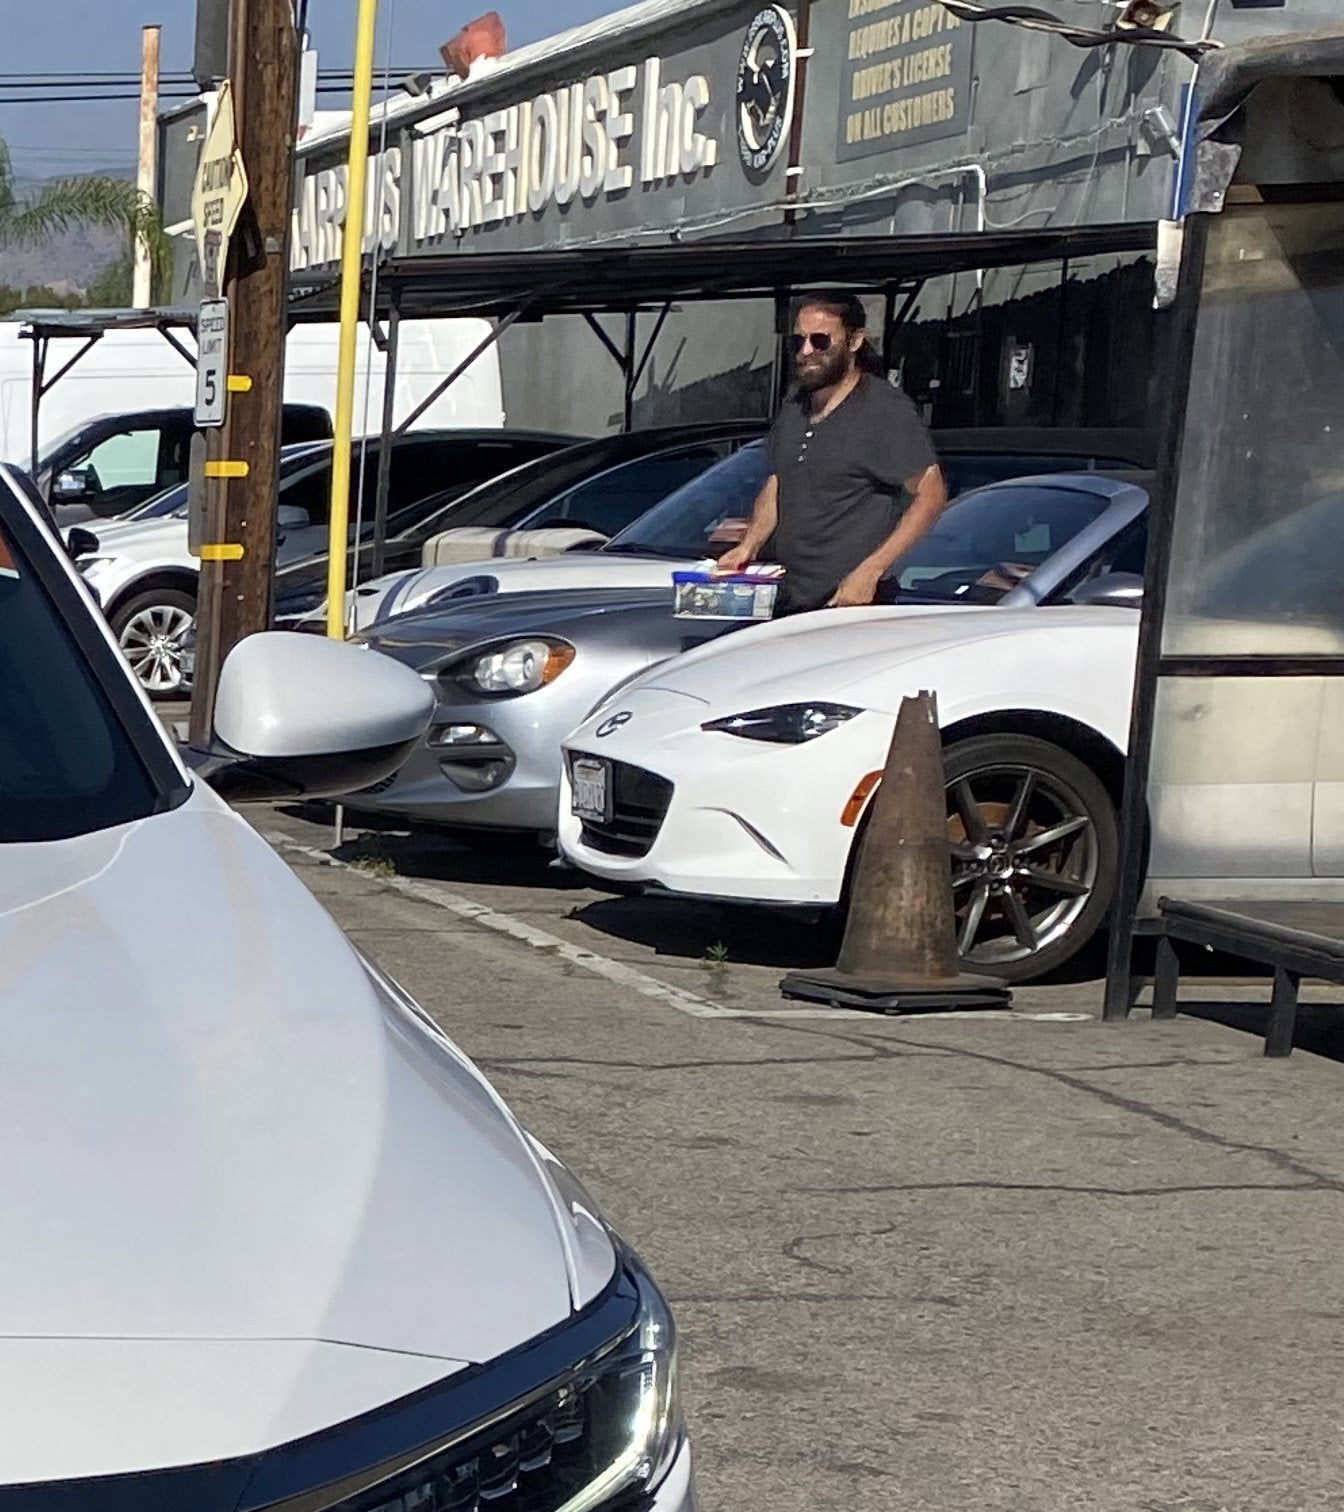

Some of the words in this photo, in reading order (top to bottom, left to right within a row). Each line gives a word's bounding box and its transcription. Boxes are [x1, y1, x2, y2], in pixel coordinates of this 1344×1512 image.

[848, 16, 901, 60] REQUIRES
[902, 13, 910, 43] A
[912, 3, 944, 41] COPY
[903, 43, 953, 87] LICENSE
[863, 107, 881, 140] ALL
[883, 87, 954, 135] CUSTOMERS
[290, 147, 402, 272] ARPUS
[413, 65, 637, 240] WAREHOUSE
[641, 56, 718, 183] Inc.
[201, 317, 225, 333] SPEED
[205, 369, 216, 406] 5
